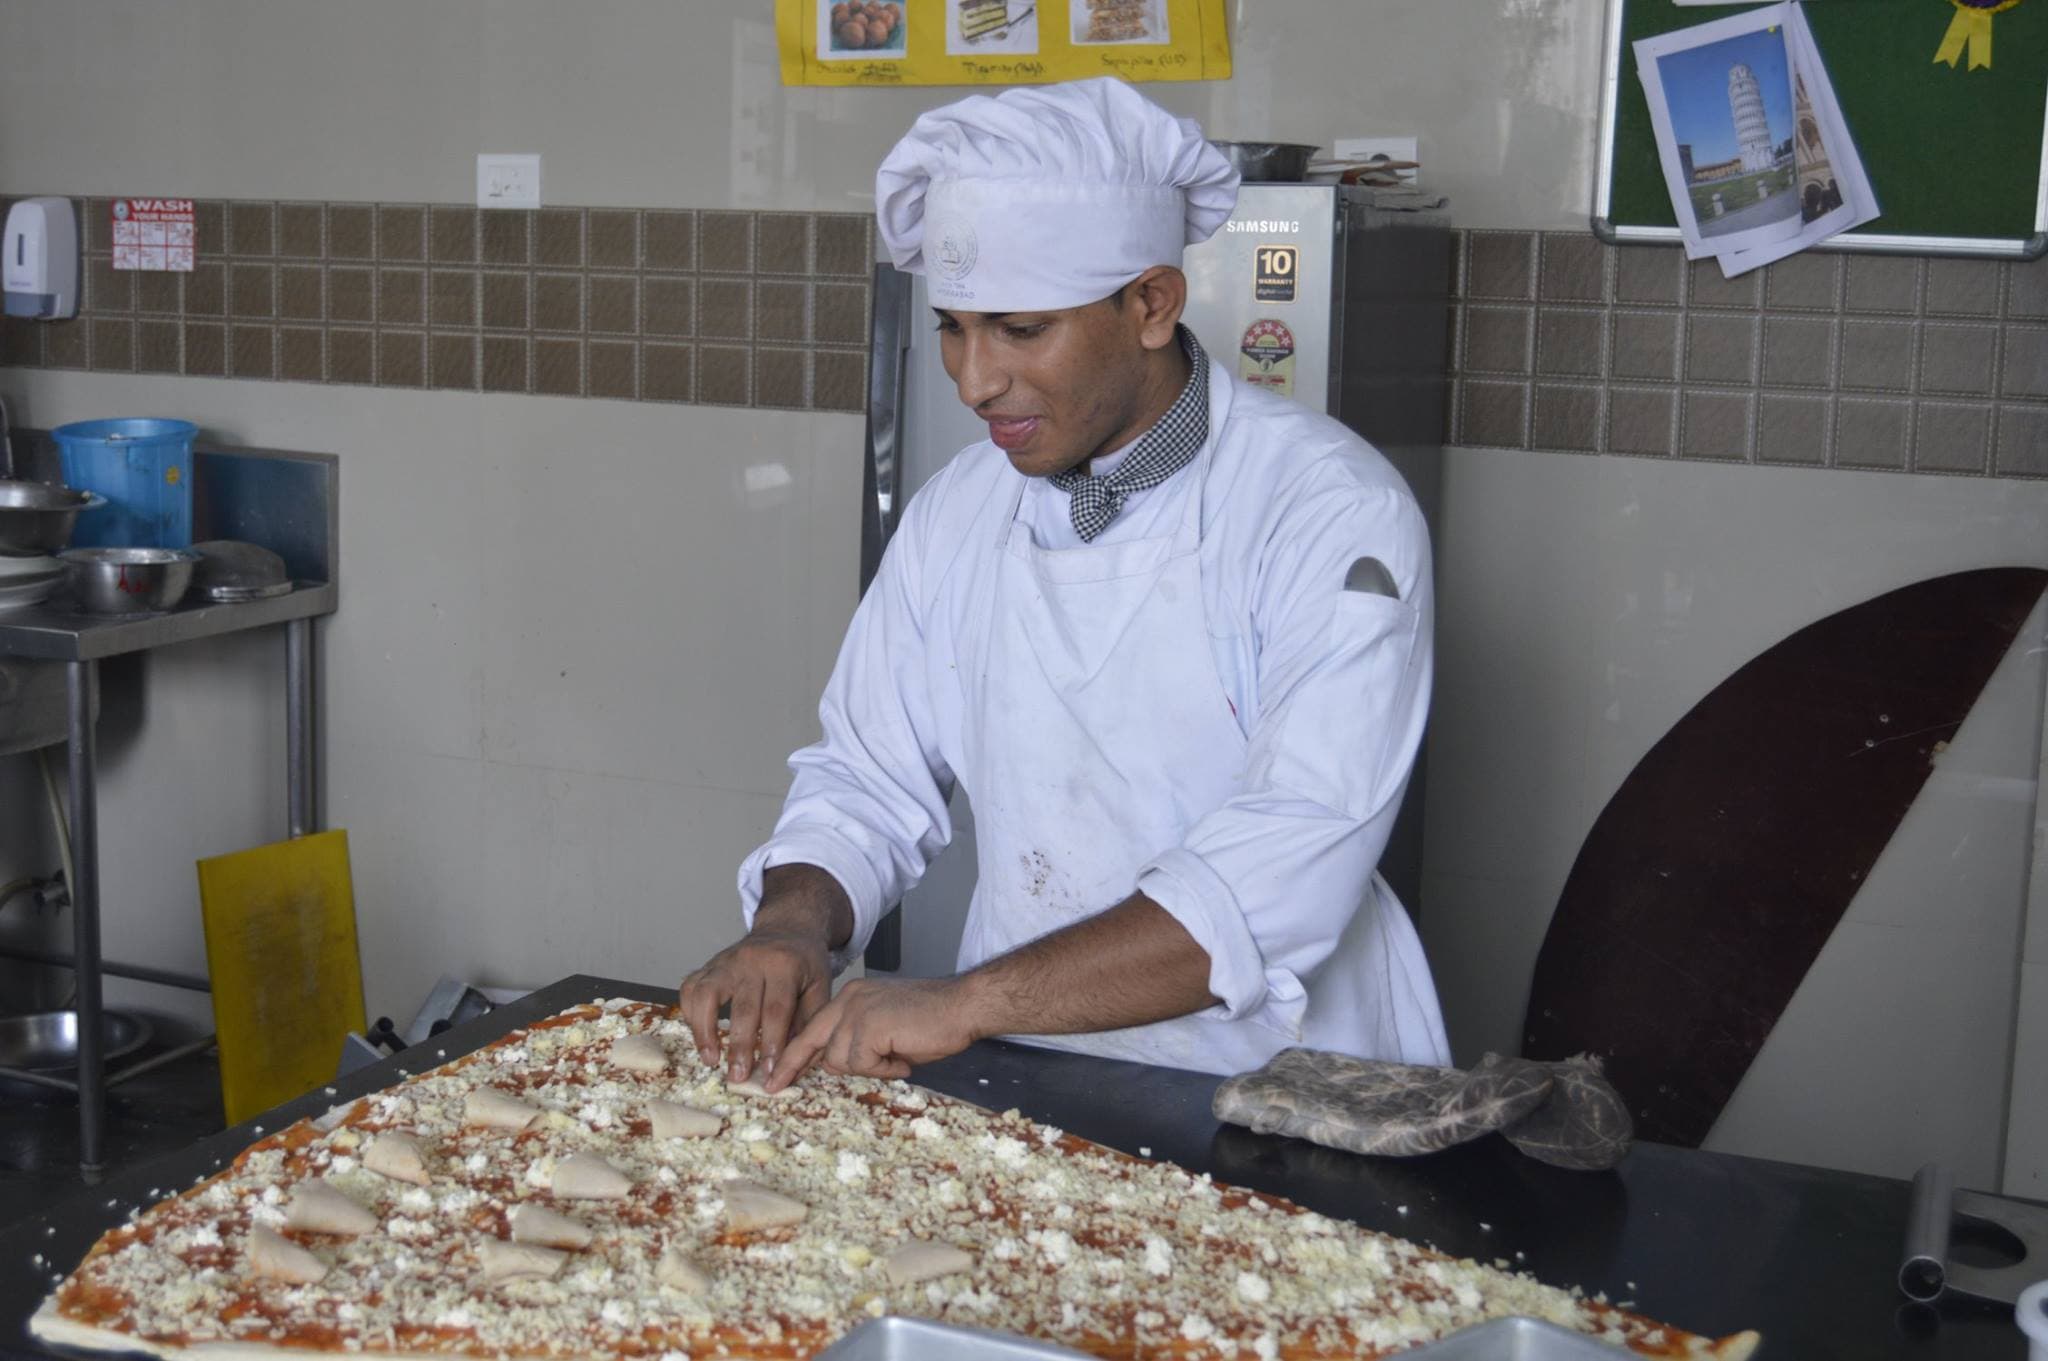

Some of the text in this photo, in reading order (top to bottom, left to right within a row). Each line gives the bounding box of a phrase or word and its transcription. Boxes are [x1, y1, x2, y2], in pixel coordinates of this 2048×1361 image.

[132, 200, 192, 211] WASH
[131, 212, 194, 221] YOUR HANDS
[1227, 221, 1299, 232] SAMSUNG
[1260, 250, 1292, 275] 10
